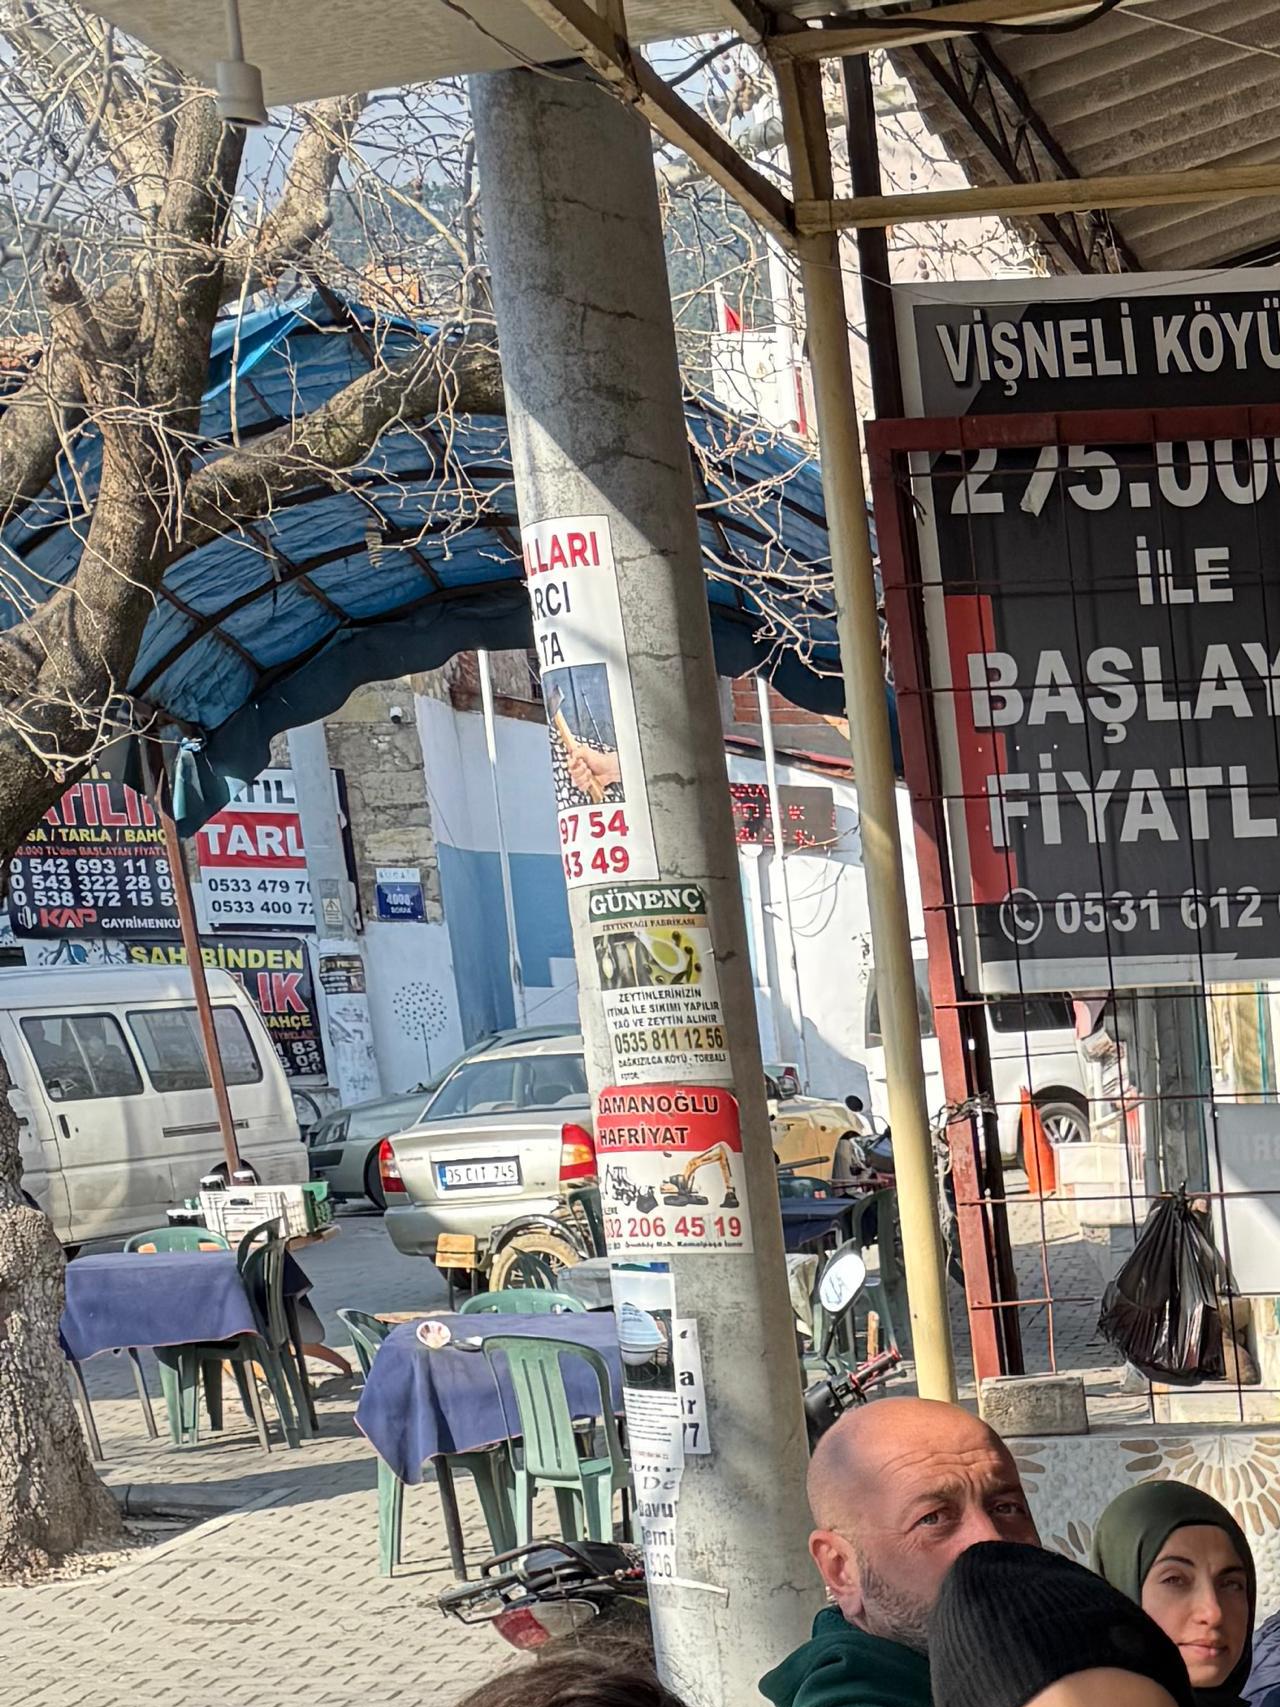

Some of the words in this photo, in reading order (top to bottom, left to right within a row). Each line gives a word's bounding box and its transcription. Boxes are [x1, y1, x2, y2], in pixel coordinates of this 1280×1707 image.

[936, 302, 1138, 396] VİŞNELİ
[1136, 536, 1234, 605] İLE
[531, 581, 571, 622] RCI
[58, 828, 112, 842] TARLA
[589, 810, 629, 839] 54
[199, 823, 306, 857] TARL
[29, 859, 70, 874] 542
[75, 859, 116, 874] 693
[123, 859, 147, 873] 11
[591, 846, 630, 874] 49
[11, 876, 25, 890] 0
[32, 876, 72, 890] 543
[78, 876, 119, 890] 322
[125, 876, 151, 890] 28
[208, 878, 252, 893] 0533
[257, 879, 290, 893] 479
[13, 891, 27, 906] 0
[34, 891, 75, 906] 538
[81, 891, 121, 906] 372
[127, 892, 153, 906] 15
[212, 900, 255, 913] 0533
[260, 901, 292, 915] 400
[590, 886, 702, 914] GÜNENÇ
[1055, 889, 1161, 934] 0531
[1180, 886, 1264, 931] 612
[40, 908, 97, 929] KAP
[101, 915, 181, 929] GAYRİMENKU
[132, 944, 304, 969] SAHBİNDEN
[264, 1015, 312, 1030] AHÇE
[632, 1018, 644, 1028] VE
[614, 1031, 648, 1054] 0535
[652, 1029, 679, 1052] 811
[685, 1028, 703, 1050] 12
[706, 1027, 724, 1049] 56
[600, 1123, 689, 1146] HAFRİYAT
[628, 1216, 666, 1238] 206
[675, 1216, 706, 1238] 45
[714, 1216, 742, 1237] 19
